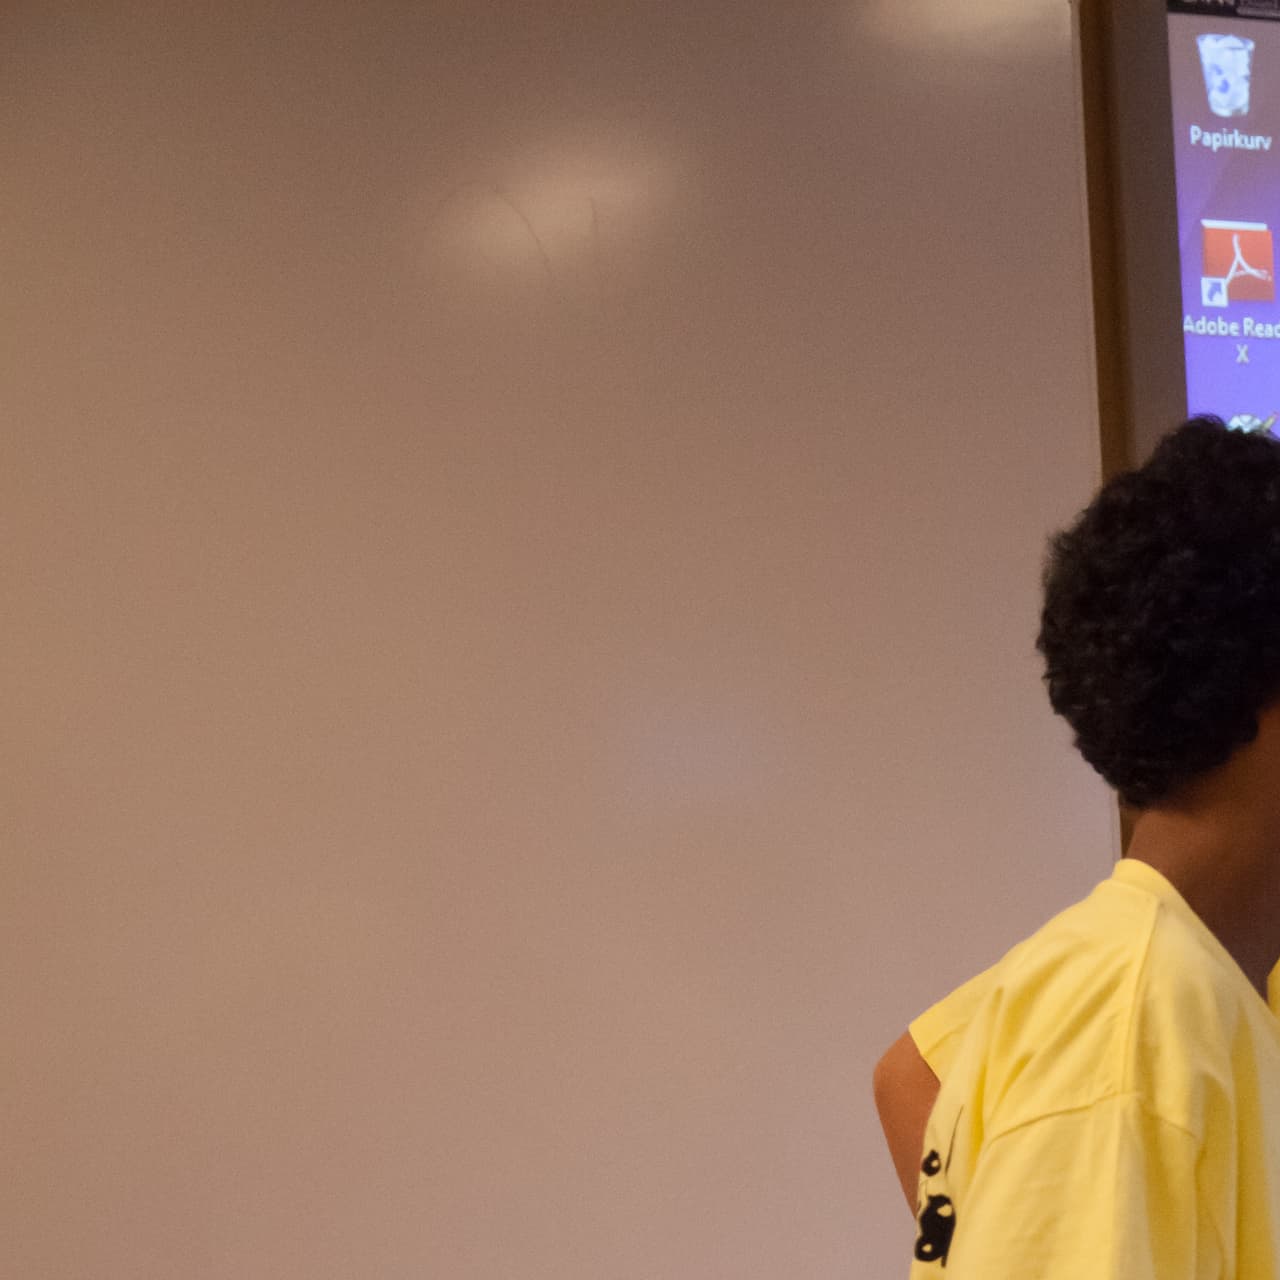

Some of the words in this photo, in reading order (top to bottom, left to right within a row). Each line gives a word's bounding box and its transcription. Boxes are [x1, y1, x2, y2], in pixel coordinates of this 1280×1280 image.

[1190, 126, 1272, 152] Papirkurv
[1183, 317, 1240, 337] Adobe
[1236, 345, 1250, 364] X
